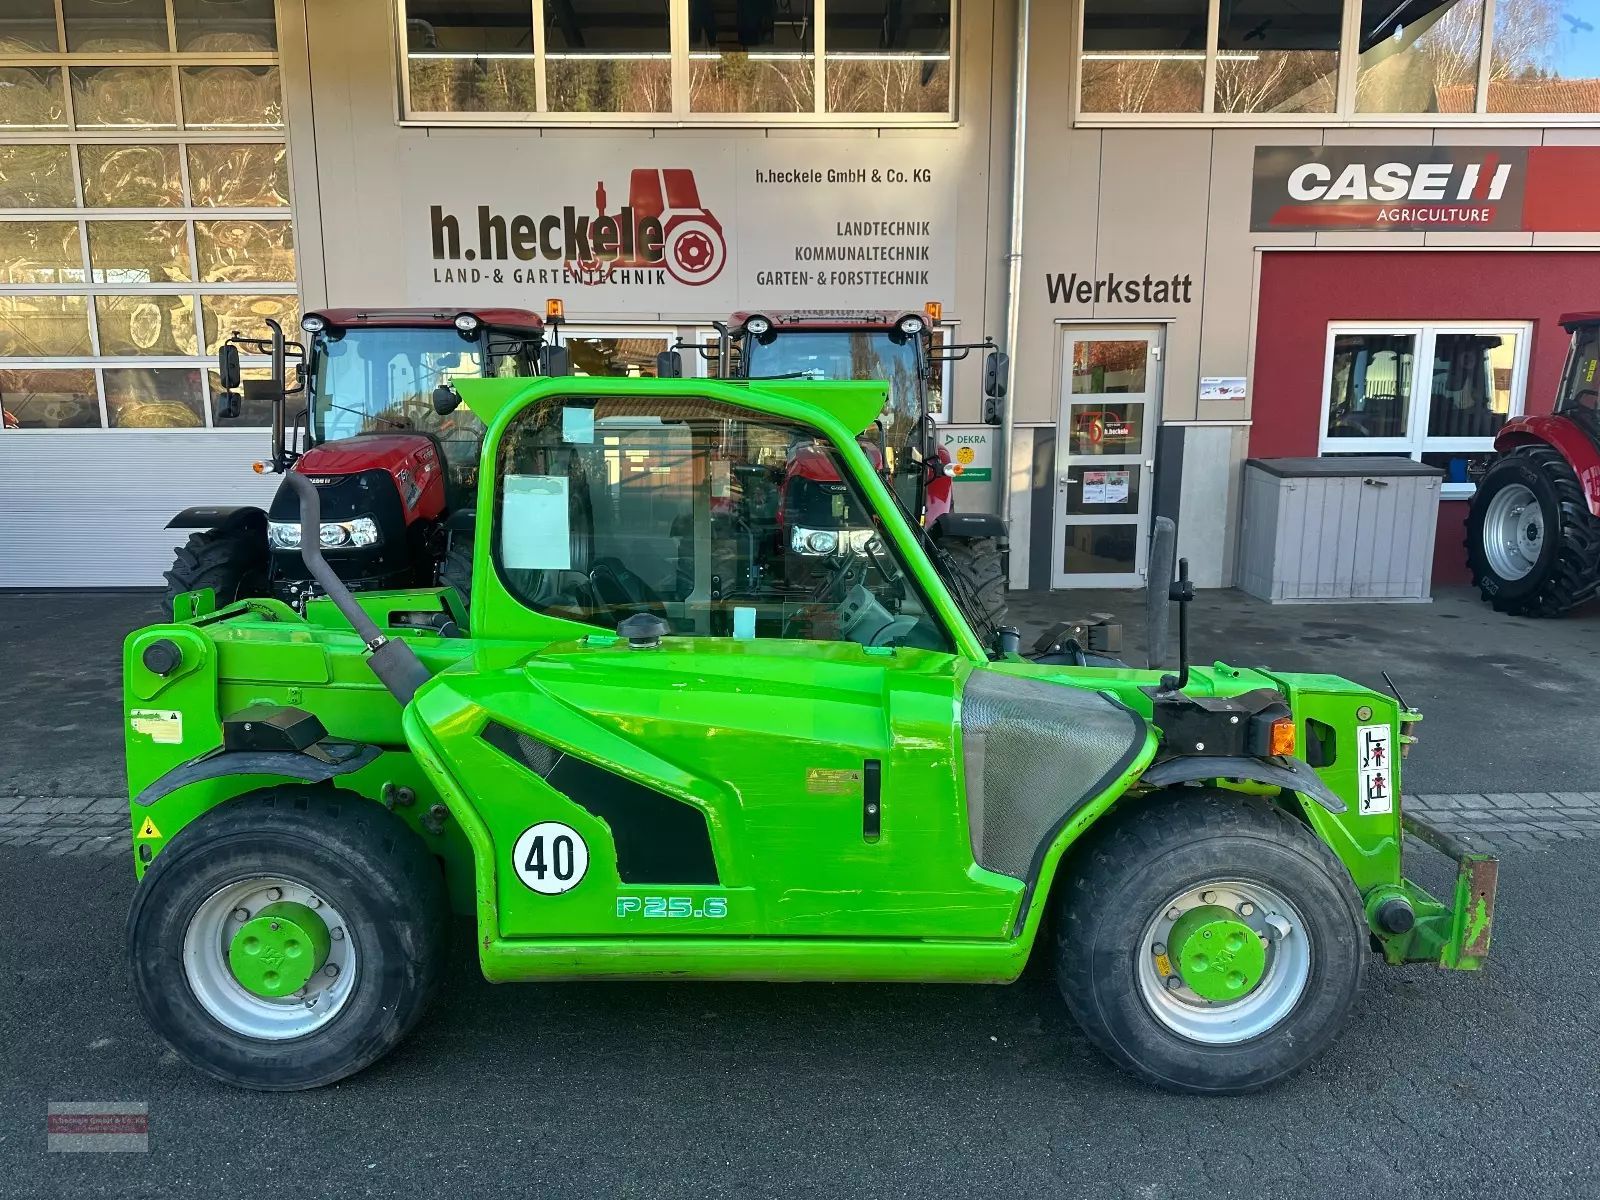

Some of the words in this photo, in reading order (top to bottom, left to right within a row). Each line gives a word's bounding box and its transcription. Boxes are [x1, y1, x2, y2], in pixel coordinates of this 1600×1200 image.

[756, 169, 822, 183] h.heckele
[827, 169, 866, 183] GmbH
[871, 169, 882, 183] &
[886, 169, 908, 183] Co.
[913, 169, 931, 183] KG
[1287, 163, 1454, 201] CASE
[1376, 208, 1490, 222] AGRICULTURE
[430, 205, 665, 263] h.heckele
[836, 221, 931, 236] LANDTECHNIK
[795, 246, 930, 261] KOMMUNALTECHNIK
[513, 268, 666, 285] GARTENTECHNIK
[756, 271, 814, 286] GARTEN-
[817, 271, 827, 285] &
[831, 270, 929, 285] FORSTTECHNIK
[1046, 273, 1192, 304] Werkstatt
[957, 435, 986, 444] DEKRA
[524, 834, 574, 881] 40
[616, 896, 728, 918] P25.6
